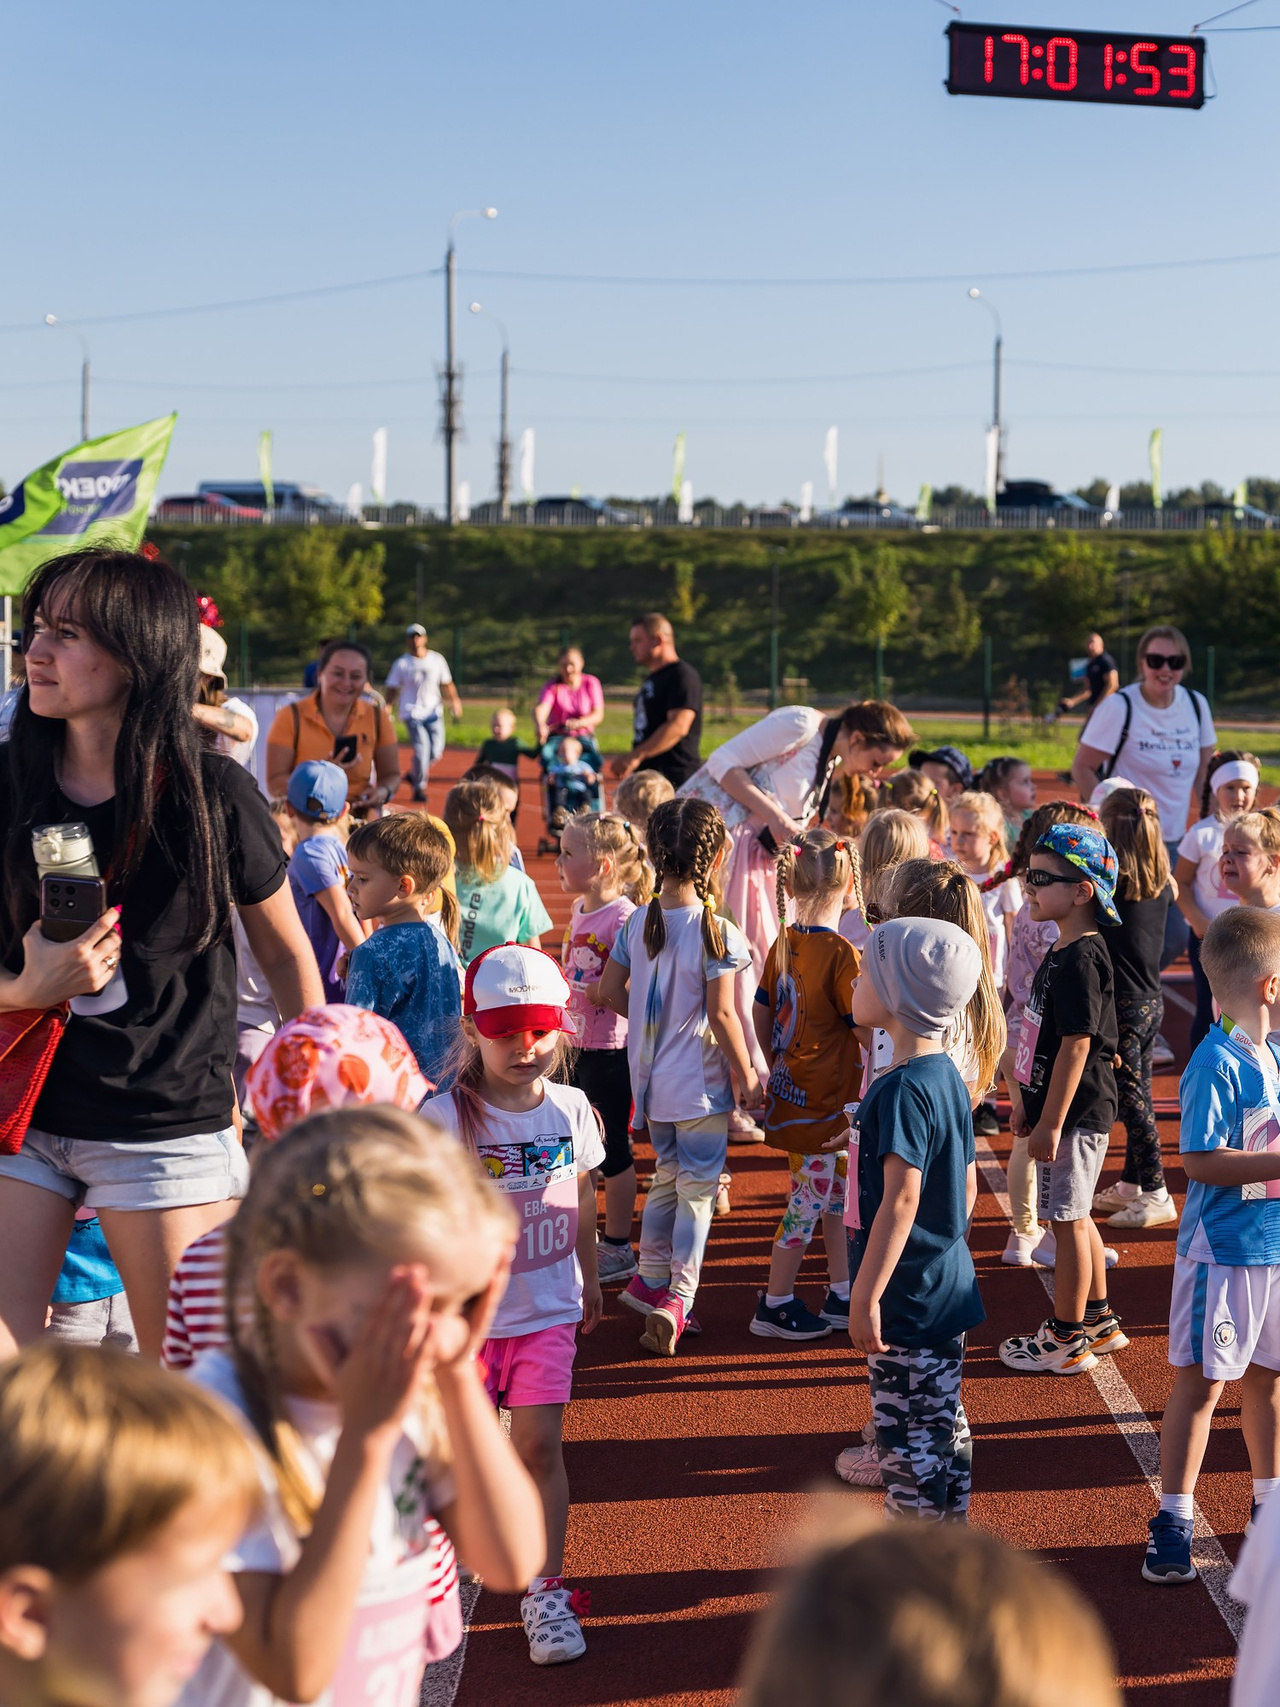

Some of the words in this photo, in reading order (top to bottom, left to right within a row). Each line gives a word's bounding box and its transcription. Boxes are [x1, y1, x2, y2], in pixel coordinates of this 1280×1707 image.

[984, 33, 1197, 98] 17:01:53
[878, 930, 886, 962] CLASSIC
[1040, 1166, 1051, 1210] NEVER
[524, 1200, 547, 1218] ЕВА
